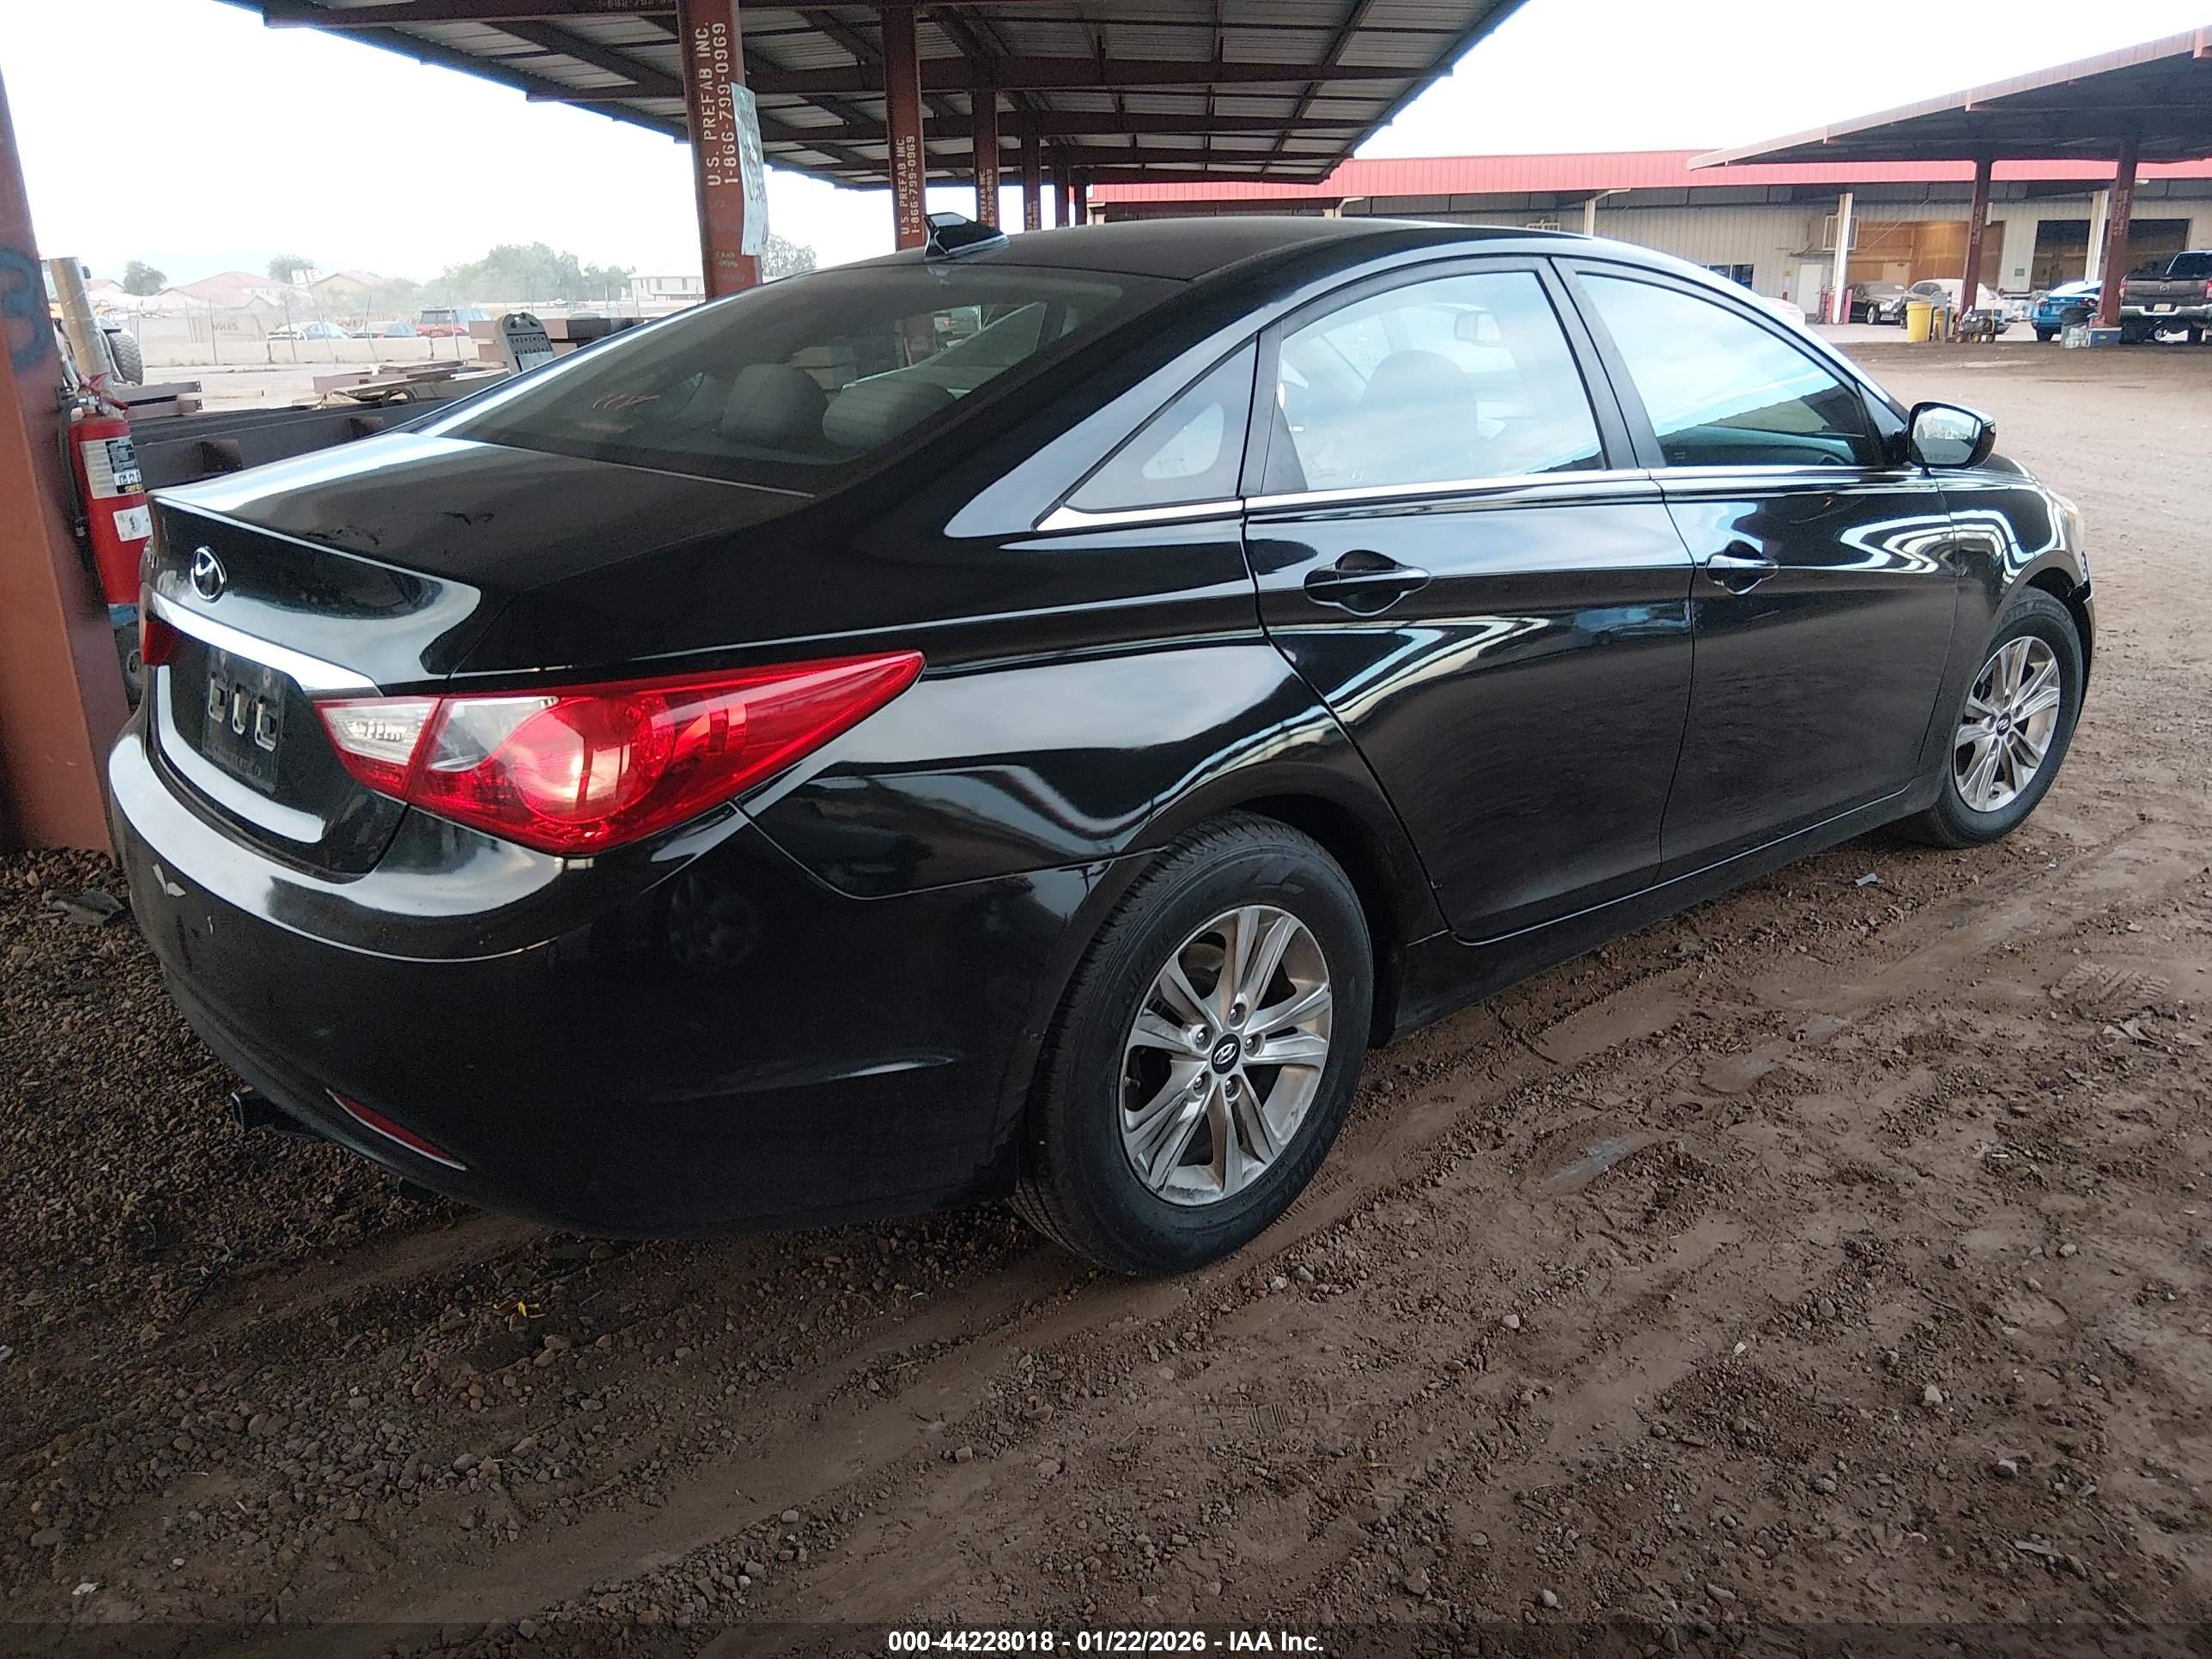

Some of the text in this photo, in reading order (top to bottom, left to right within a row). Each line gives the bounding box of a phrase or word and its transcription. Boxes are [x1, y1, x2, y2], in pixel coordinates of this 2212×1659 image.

[695, 21, 721, 186] U.S. PREFAB INC.
[711, 22, 739, 185] 1-866-799-0969
[896, 162, 908, 207] PREFAB
[900, 213, 910, 235] U.S.
[906, 136, 921, 234] 1-866-799-0969
